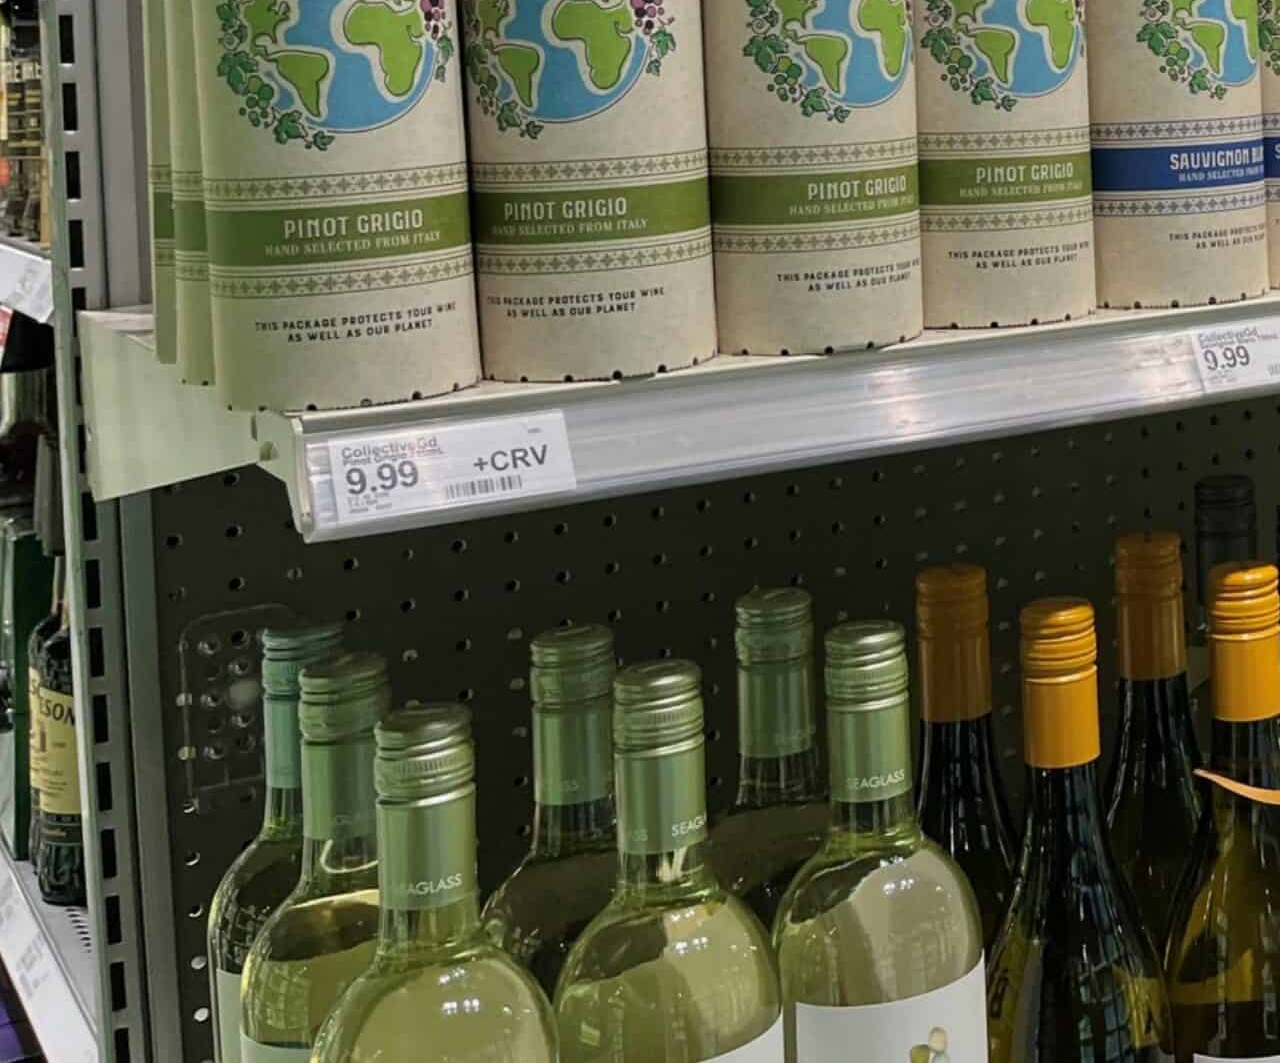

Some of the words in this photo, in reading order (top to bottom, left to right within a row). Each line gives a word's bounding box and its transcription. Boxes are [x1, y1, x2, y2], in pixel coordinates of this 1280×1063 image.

[1169, 147, 1249, 170] SAUVIGNON
[976, 166, 1026, 184] PINOT
[1031, 162, 1073, 181] GRIGIO
[808, 180, 860, 200] PINOT
[865, 175, 906, 196] GRIGIO
[504, 201, 556, 221] PINOT
[563, 197, 628, 219] GRIGIO
[284, 215, 348, 238] PINOT
[357, 209, 423, 234] GRIGIO
[519, 221, 575, 235] SELECTED
[579, 220, 613, 233] FROM
[617, 218, 648, 231] ITALY
[304, 239, 370, 254] SELECTED
[375, 234, 410, 249] FROM
[413, 230, 441, 244] ITALY
[548, 292, 604, 306] PROTECTS
[609, 289, 636, 301] YOUR
[283, 317, 336, 331] PACKAGE
[342, 311, 401, 327] PROTECTS
[522, 307, 547, 318] WELL
[552, 307, 565, 317] AS
[570, 306, 592, 316] OUR
[597, 302, 636, 314] PLANET
[307, 331, 340, 342] WELL
[347, 328, 362, 338] AS
[1204, 345, 1249, 371] 9.99
[473, 444, 548, 472] +CRV
[346, 460, 418, 494] 9.99
[672, 816, 705, 837] SEAG
[408, 873, 463, 895] AGLASS
